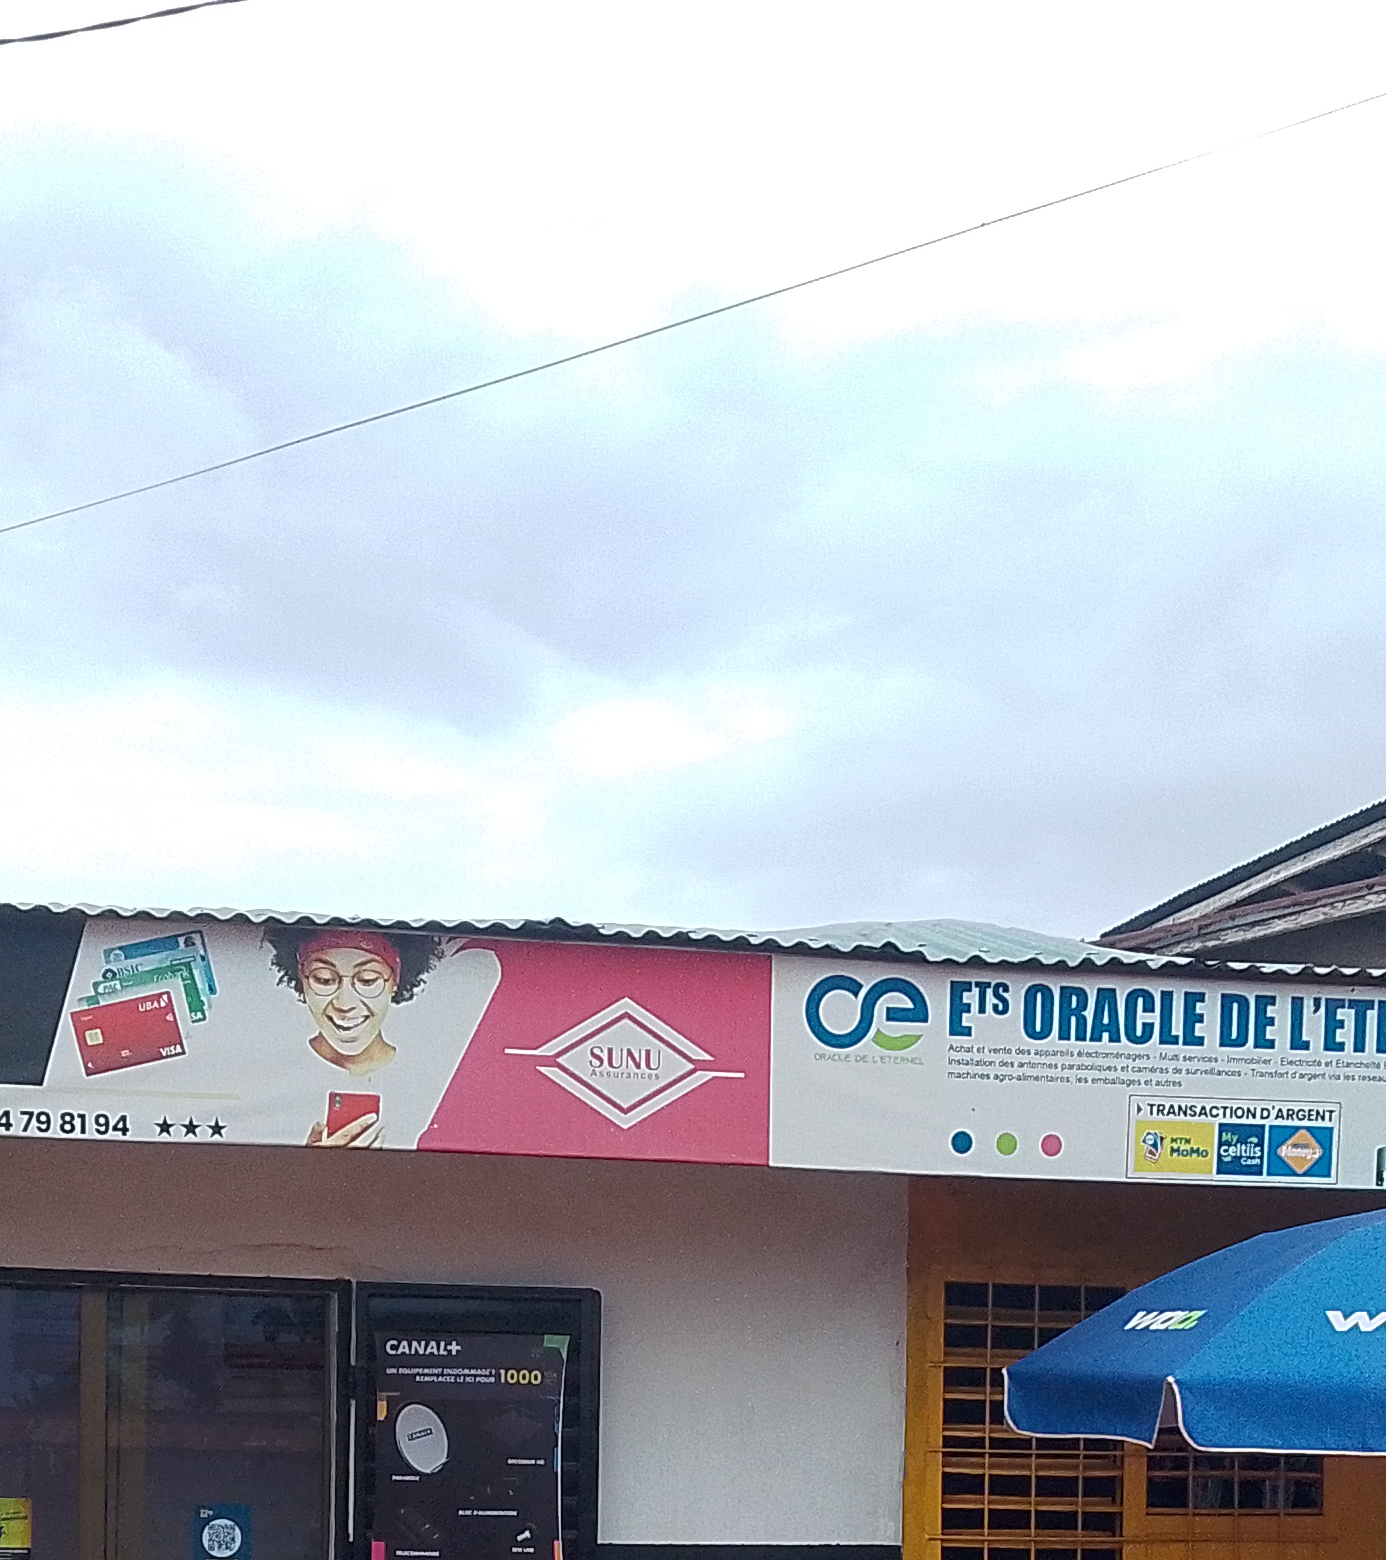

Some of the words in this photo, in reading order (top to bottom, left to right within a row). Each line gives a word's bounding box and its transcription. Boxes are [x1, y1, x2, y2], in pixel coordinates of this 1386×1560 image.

[138, 1000, 160, 1012] UBA
[1023, 983, 1207, 1047] ORACLE
[1218, 992, 1278, 1051] DE
[160, 1043, 183, 1057] VISA
[589, 1045, 662, 1071] SUNU
[947, 1043, 974, 1054] Achat
[976, 1045, 986, 1054] et
[987, 1046, 1013, 1055] vente
[1014, 1046, 1032, 1056] des
[1324, 1059, 1334, 1068] et
[855, 1054, 870, 1064] DE
[590, 1068, 660, 1080] Assurances
[947, 1056, 996, 1068] Installation
[998, 1058, 1015, 1068] des
[1120, 1063, 1130, 1073] et
[1171, 1065, 1184, 1075] de
[1328, 1072, 1342, 1082] via
[1343, 1072, 1357, 1082] les
[947, 1070, 991, 1081] machines
[1075, 1074, 1089, 1084] les
[1143, 1078, 1153, 1087] et
[1154, 1078, 1183, 1088] autres
[1147, 1102, 1258, 1121] TRANSACTION
[1260, 1105, 1337, 1123] D'ARGENT
[22, 1110, 51, 1134] 79
[59, 1112, 86, 1136] 81
[94, 1114, 130, 1137] 94
[1169, 1146, 1210, 1159] MoMo
[385, 1339, 462, 1355] CANAL+
[499, 1368, 542, 1385] 1000
